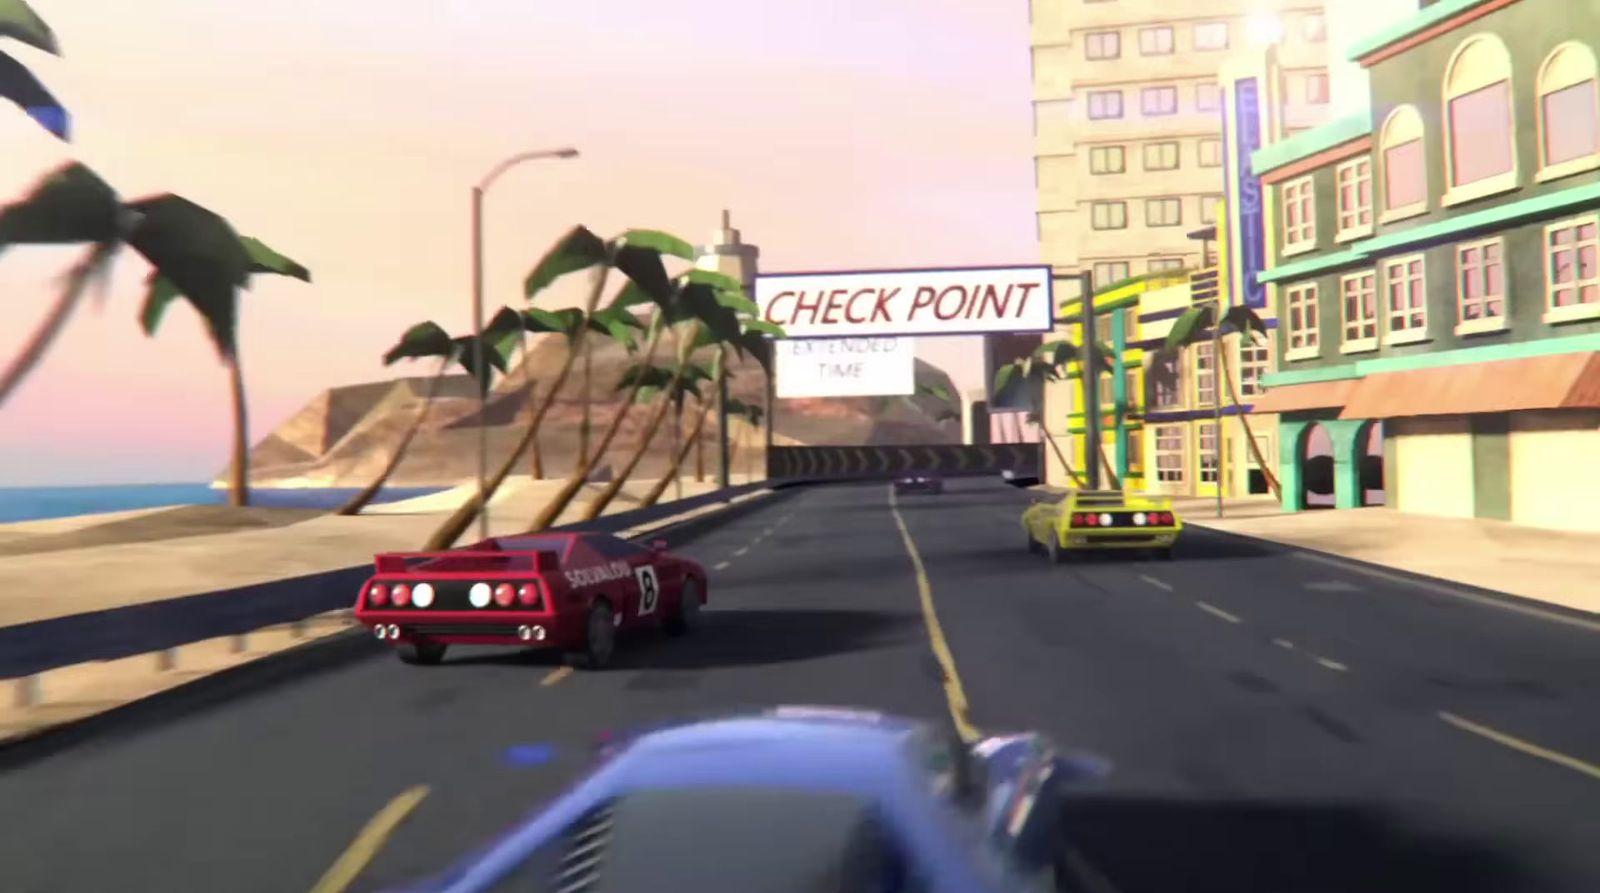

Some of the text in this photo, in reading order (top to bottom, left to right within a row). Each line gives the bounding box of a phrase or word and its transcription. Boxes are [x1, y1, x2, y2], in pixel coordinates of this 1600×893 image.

[764, 282, 1041, 325] CHECK POINT
[792, 338, 899, 356] EXTENDED
[818, 362, 865, 379] TIME
[642, 570, 655, 610] 8
